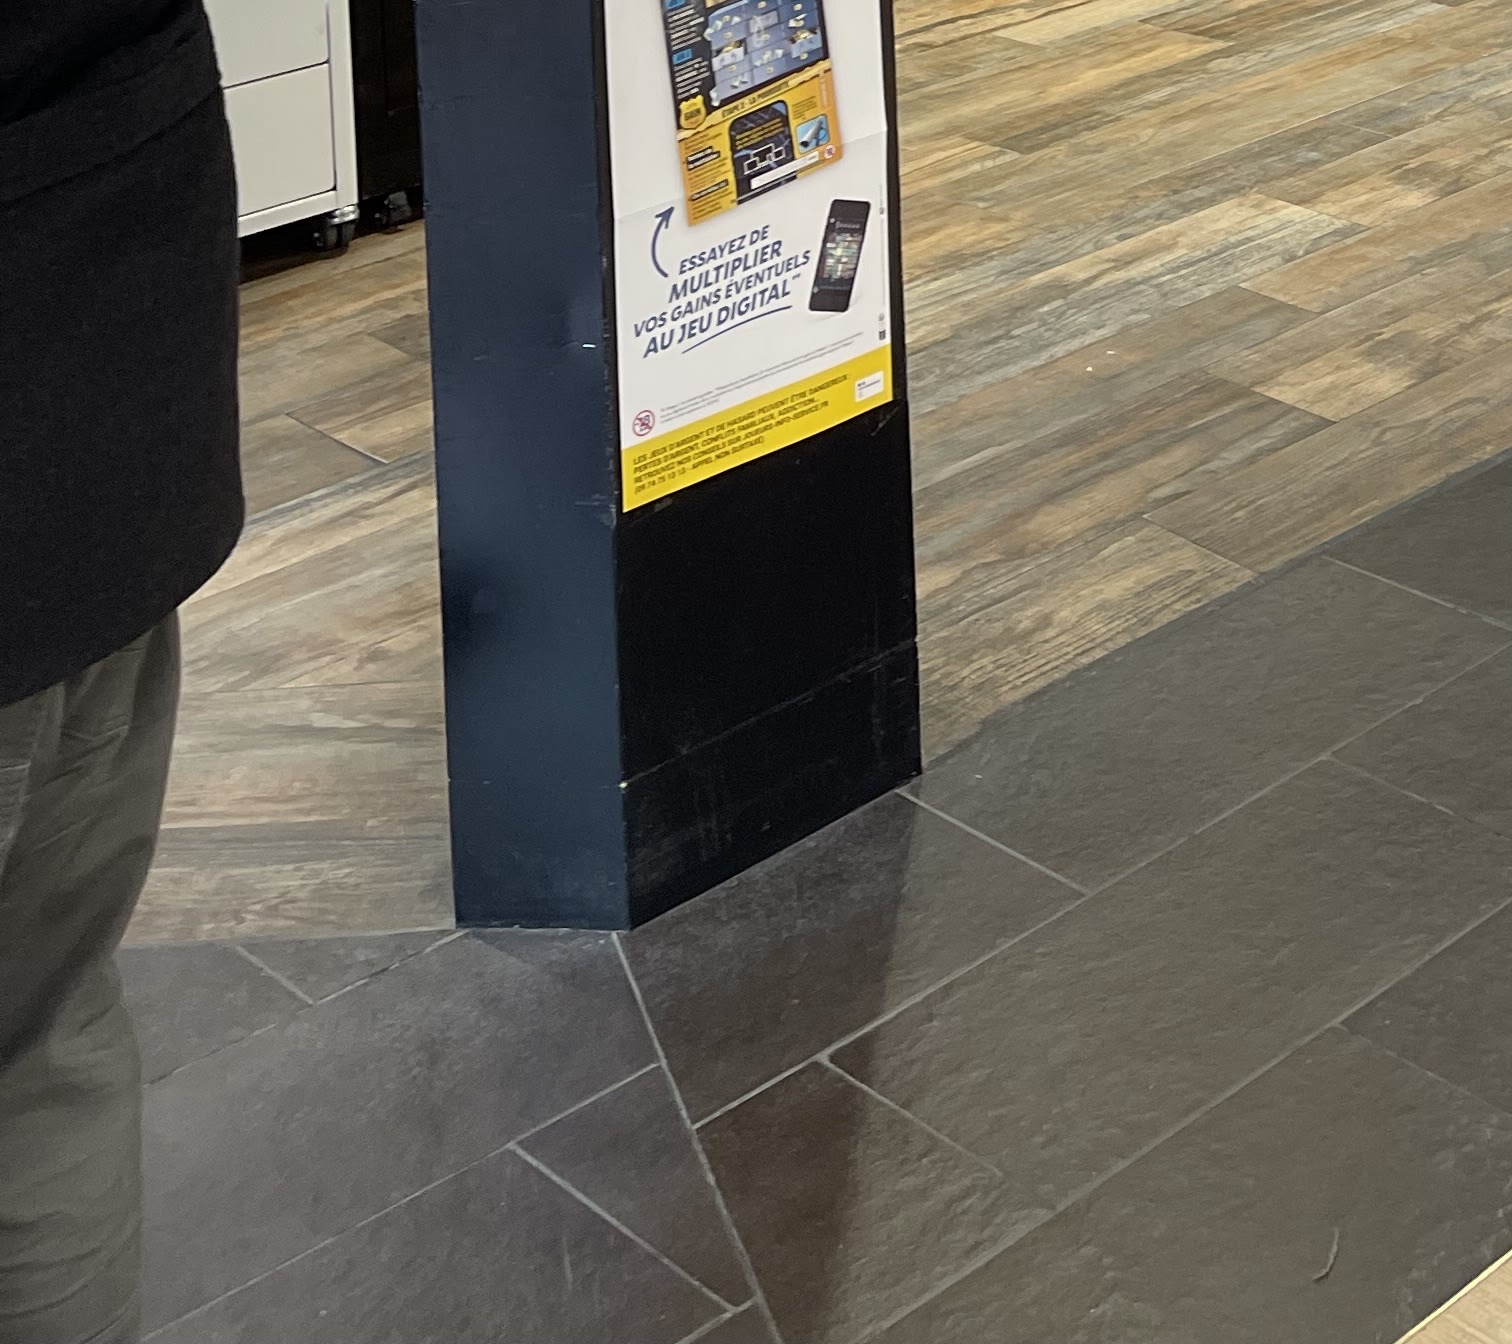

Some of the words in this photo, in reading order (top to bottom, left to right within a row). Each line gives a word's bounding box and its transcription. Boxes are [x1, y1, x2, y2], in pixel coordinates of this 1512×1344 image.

[668, 239, 783, 304] MULTIPLIER
[679, 234, 748, 276] ESSAYEZ
[749, 225, 770, 243] DE
[633, 312, 668, 338] VOS
[670, 290, 721, 323] GAINS
[724, 250, 811, 299] ÉVENTUELS
[643, 337, 674, 359] AU
[677, 317, 713, 344] JEU
